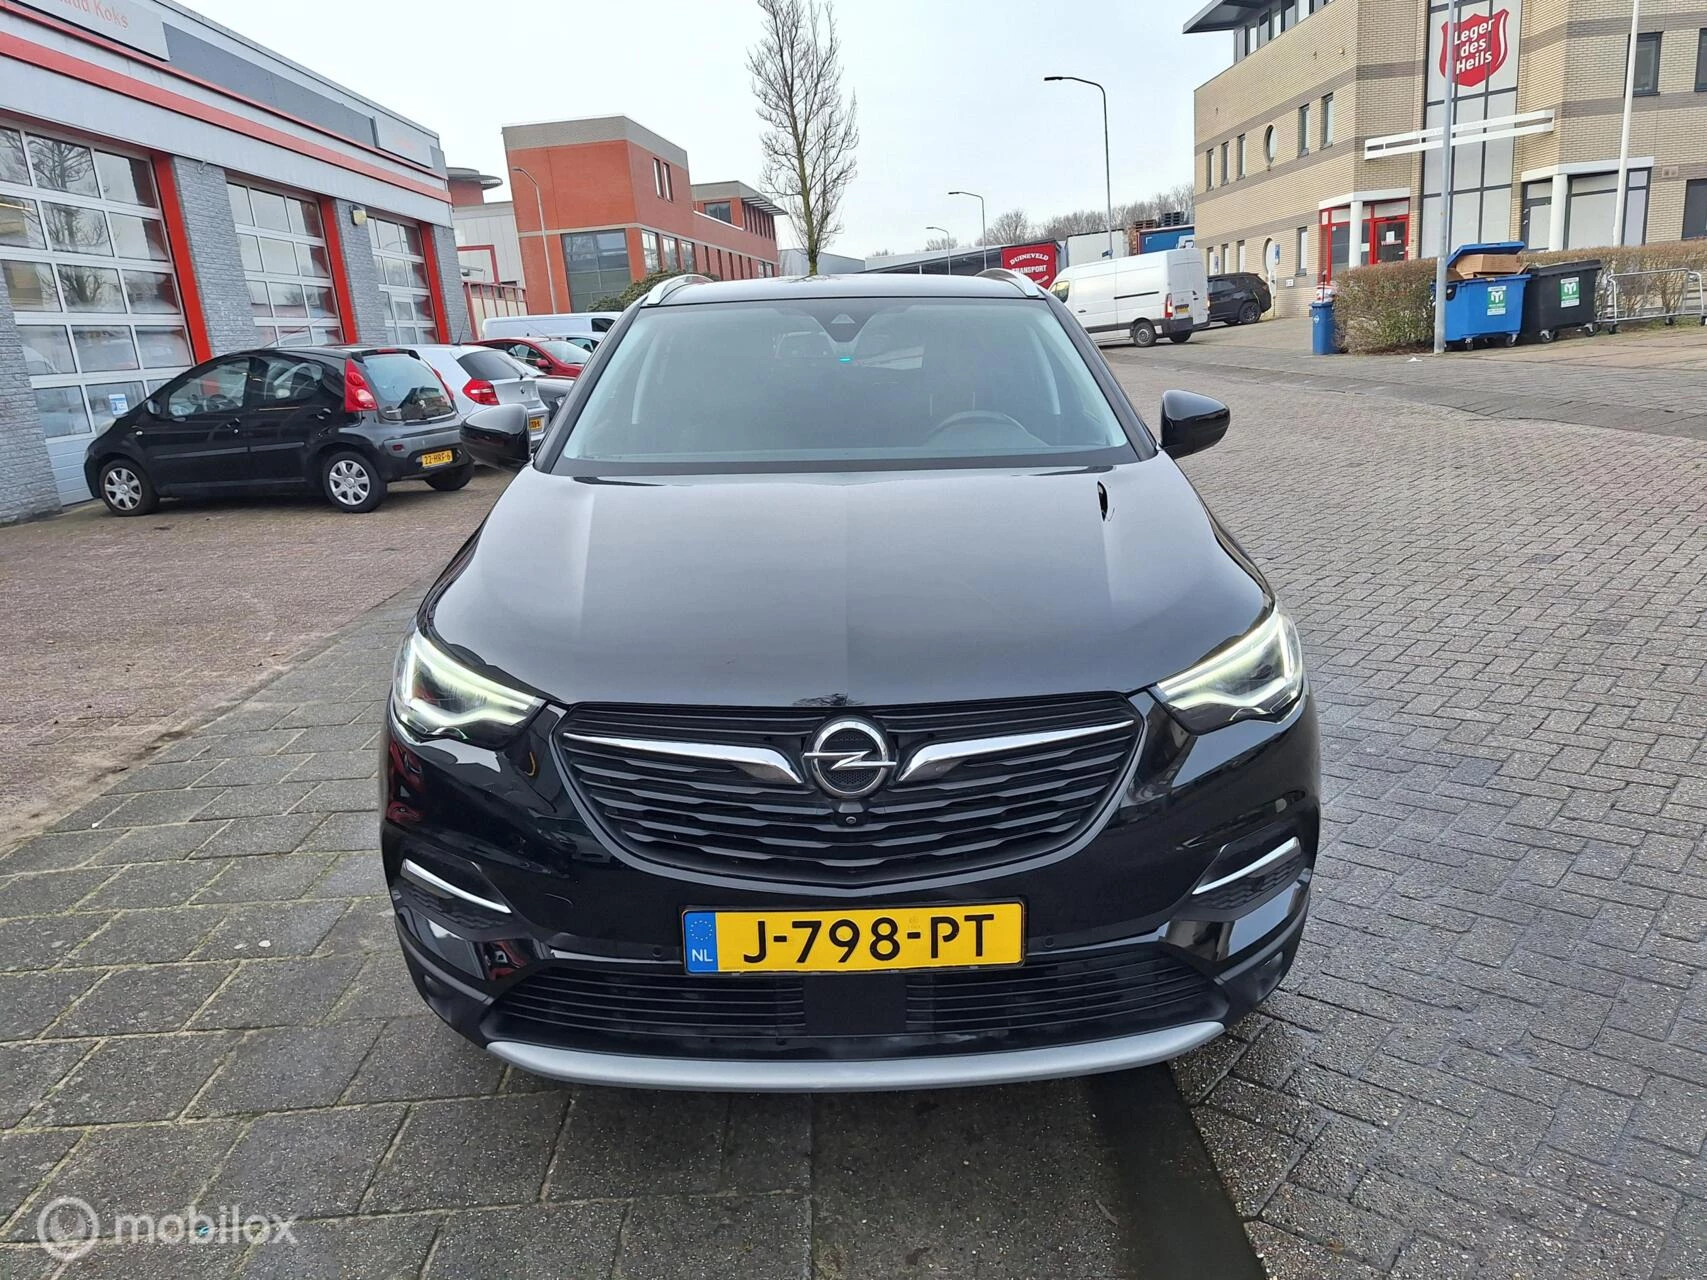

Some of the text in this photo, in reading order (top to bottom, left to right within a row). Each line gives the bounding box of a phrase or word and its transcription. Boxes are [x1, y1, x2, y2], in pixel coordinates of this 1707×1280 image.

[93, 0, 128, 28] Koks
[1454, 19, 1495, 45] Leger
[1460, 38, 1486, 57] des
[1456, 51, 1492, 74] Heils
[1009, 253, 1049, 265] DUINEVELD
[743, 914, 994, 963] J-798-PT
[692, 948, 713, 963] NL
